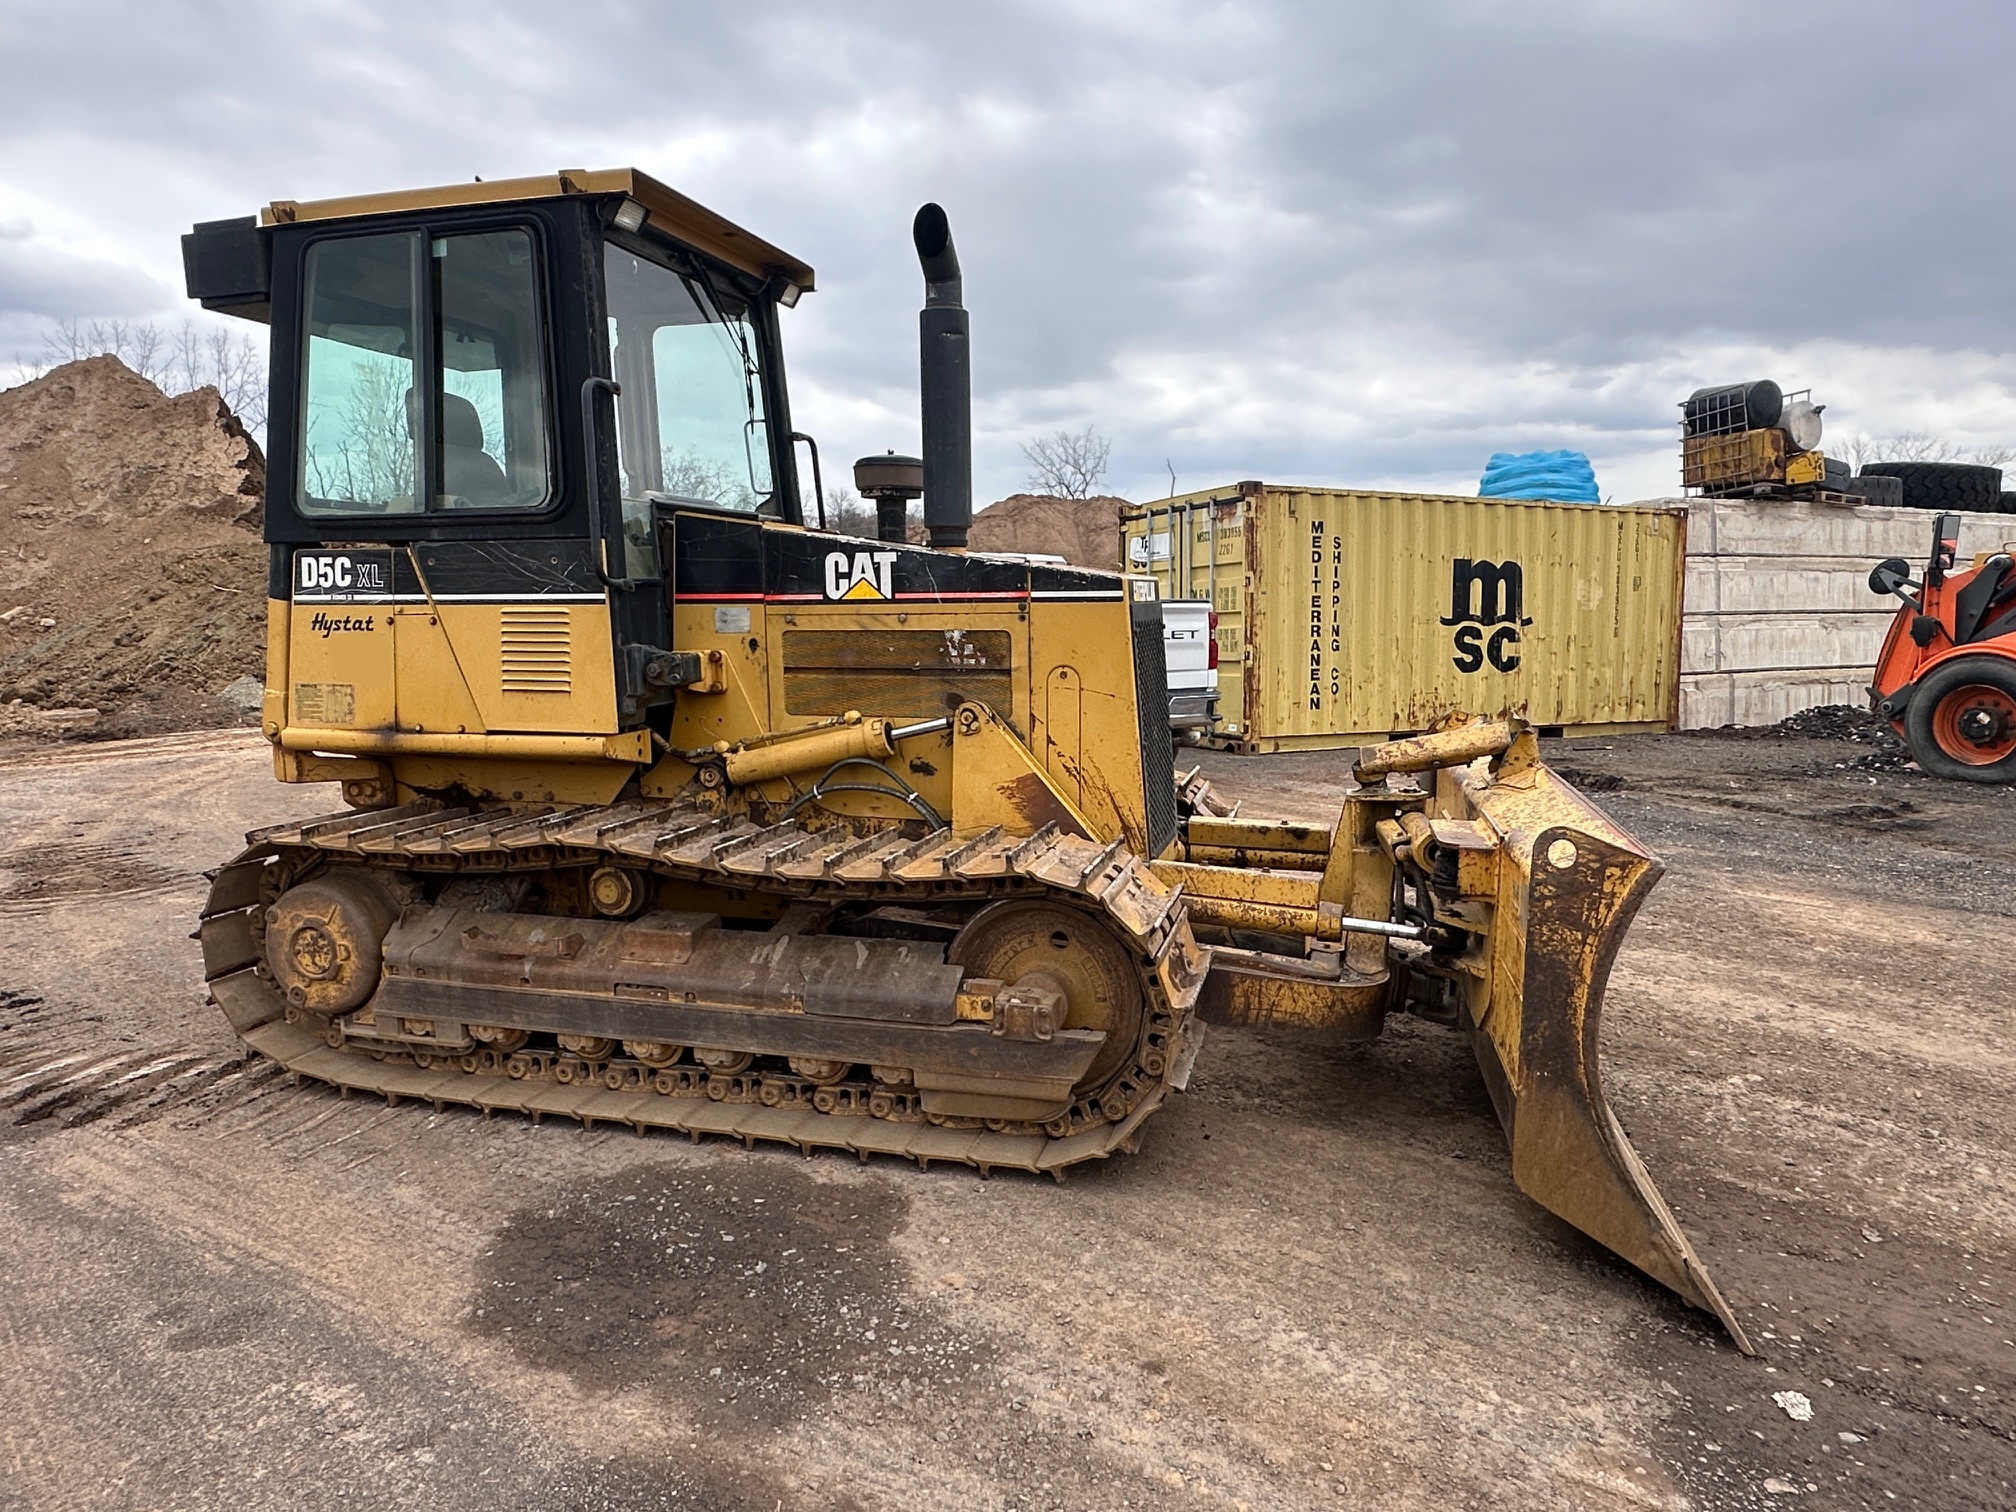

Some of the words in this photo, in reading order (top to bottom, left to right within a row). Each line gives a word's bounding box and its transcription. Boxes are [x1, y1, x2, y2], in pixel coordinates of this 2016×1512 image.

[301, 556, 352, 588] D5C
[356, 564, 384, 588] XL
[824, 552, 898, 600] CAT
[1331, 536, 1342, 652] SHIPPING
[311, 612, 375, 639] Hystat
[1310, 521, 1324, 710] MEDITERRANEAN
[1452, 625, 1522, 673] SC
[1330, 667, 1340, 695] CO
